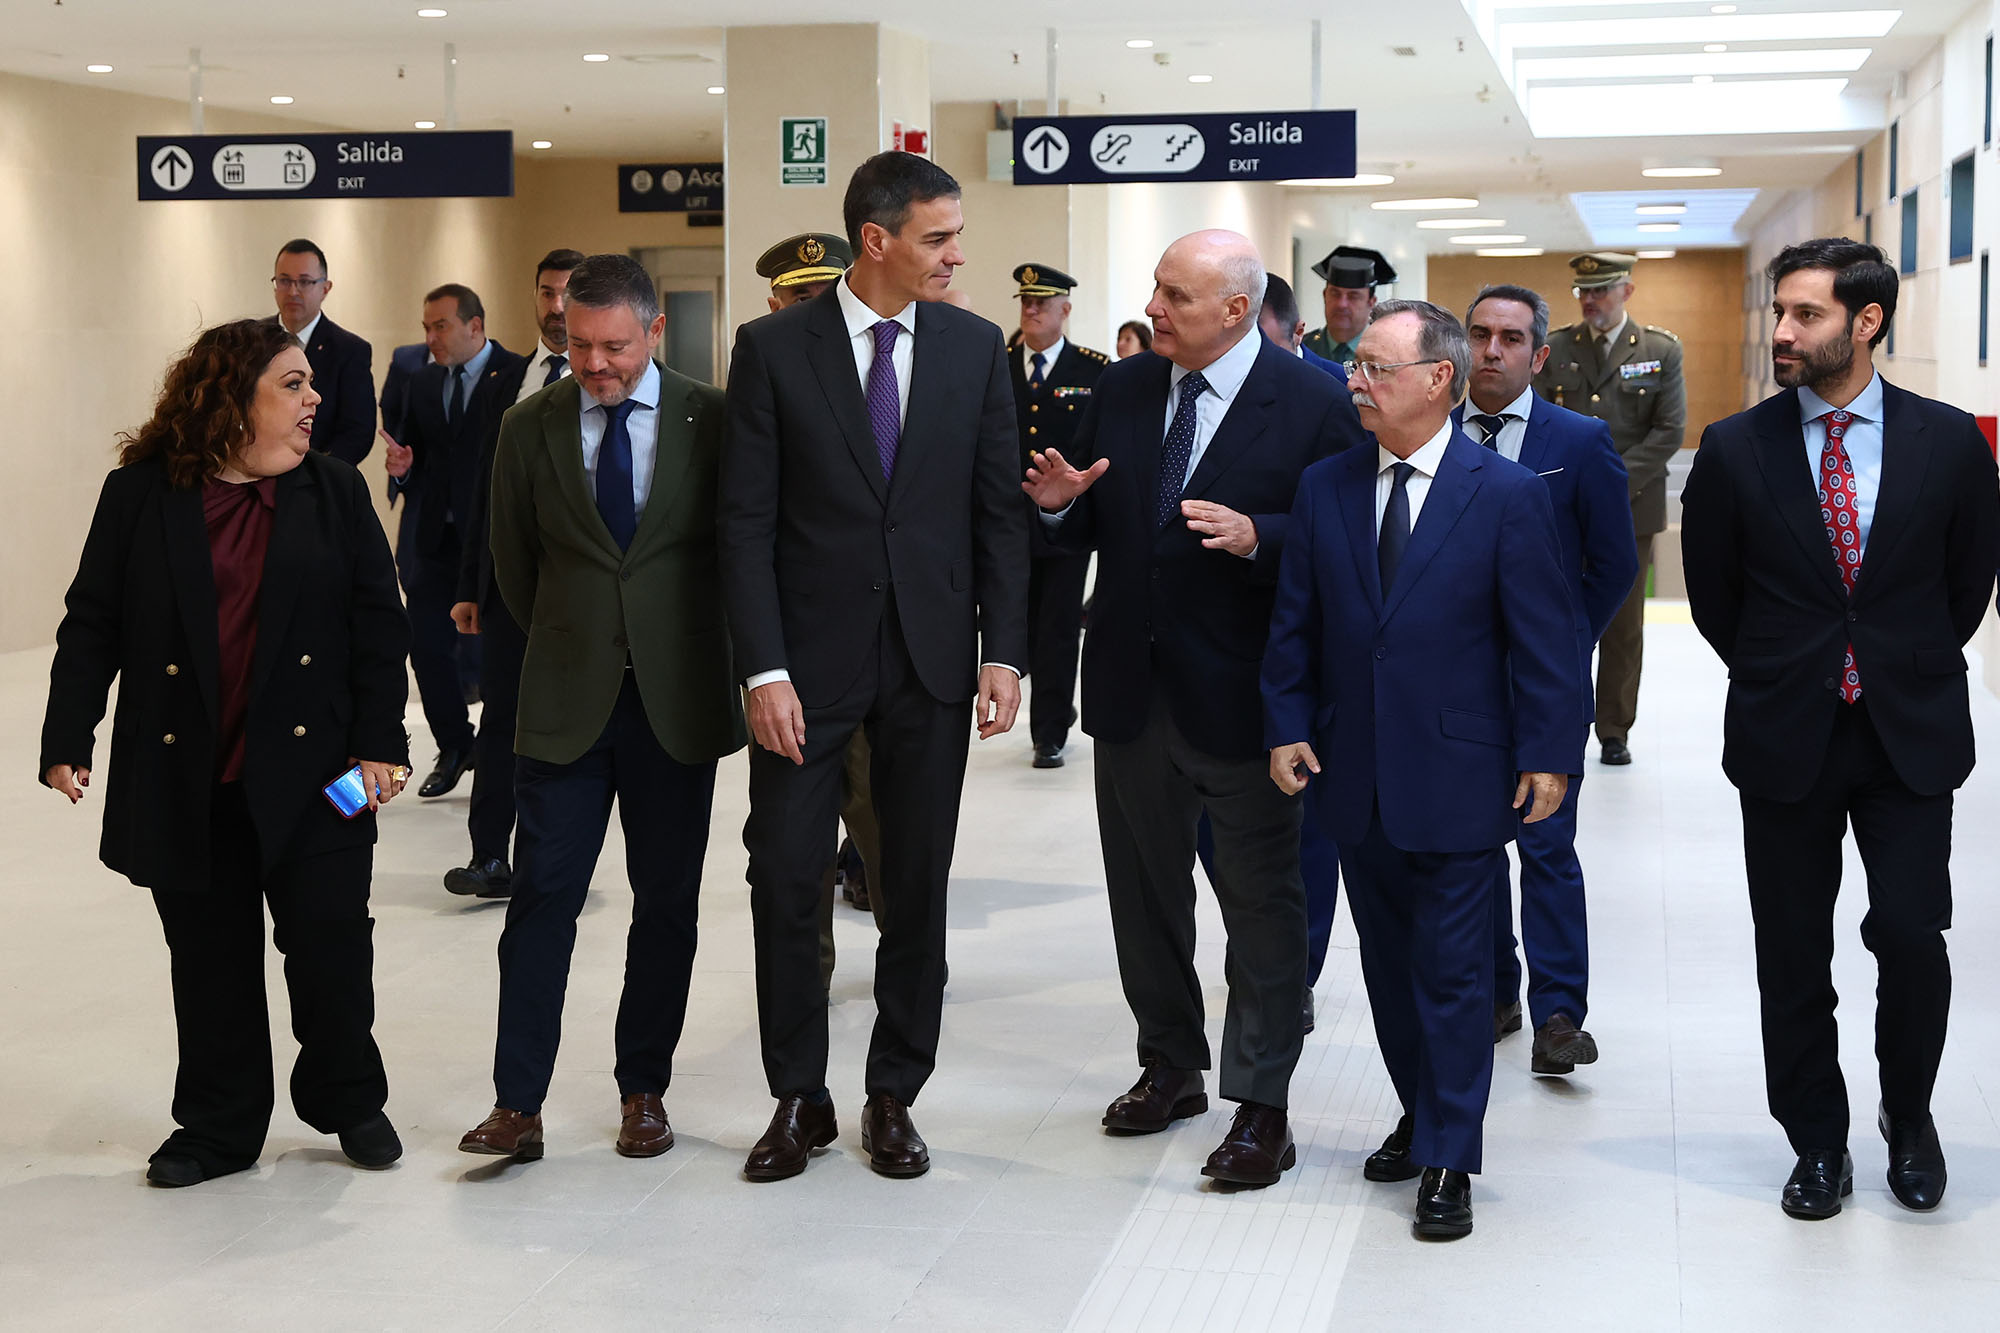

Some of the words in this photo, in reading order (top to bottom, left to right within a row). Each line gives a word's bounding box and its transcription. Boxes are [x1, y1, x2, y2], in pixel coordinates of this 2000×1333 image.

[1229, 120, 1303, 145] Salida
[337, 140, 404, 163] Salida
[1229, 158, 1260, 172] EXIT
[337, 176, 366, 189] EXIT
